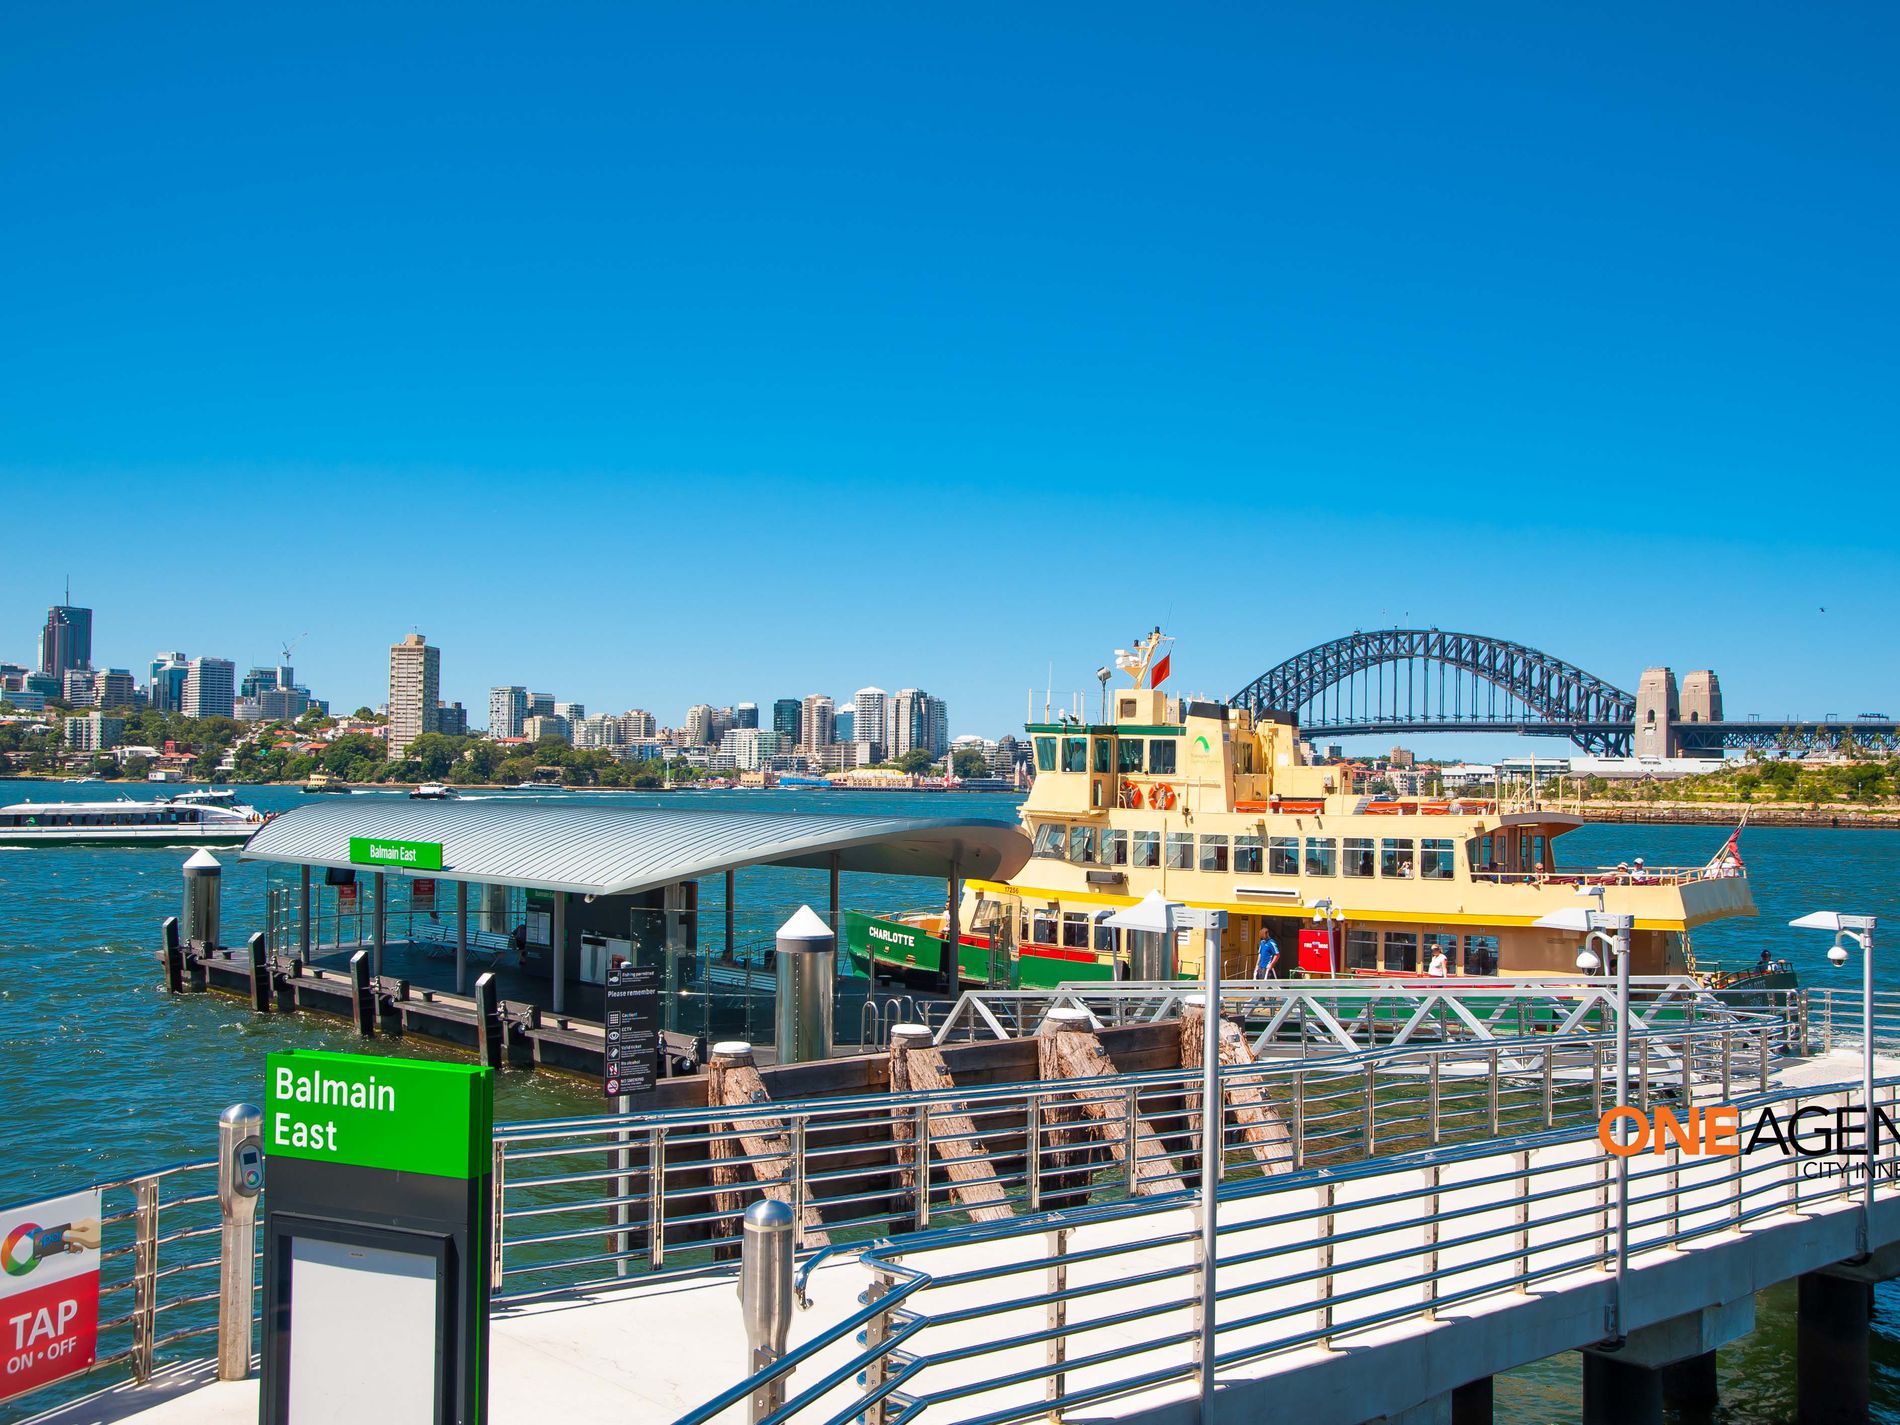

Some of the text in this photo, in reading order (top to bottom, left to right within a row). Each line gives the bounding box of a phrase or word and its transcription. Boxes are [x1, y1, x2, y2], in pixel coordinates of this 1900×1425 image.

[370, 844, 416, 861] Balmain East
[869, 926, 915, 947] CHARLOTTE
[627, 988, 656, 996] remember
[276, 1066, 396, 1112] Balmain
[274, 1112, 338, 1151] East
[9, 1299, 78, 1350] TAP
[6, 1336, 77, 1374] ON OFF
